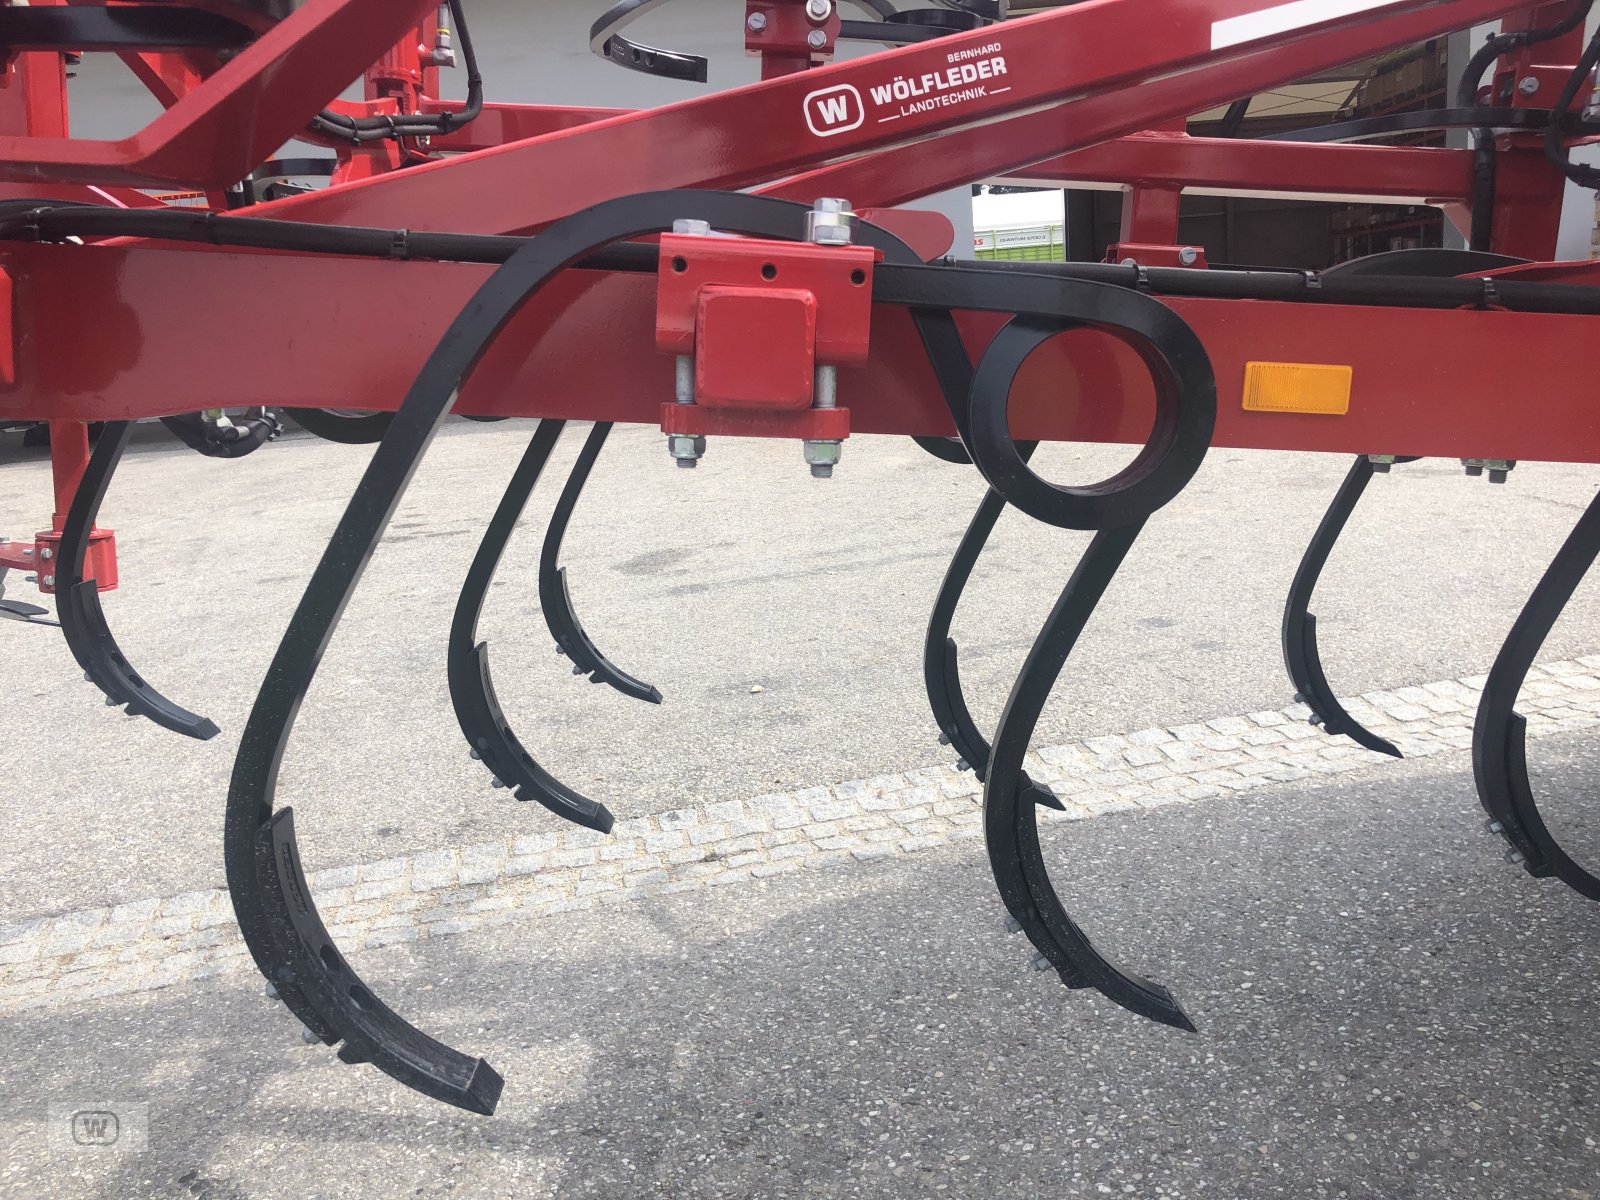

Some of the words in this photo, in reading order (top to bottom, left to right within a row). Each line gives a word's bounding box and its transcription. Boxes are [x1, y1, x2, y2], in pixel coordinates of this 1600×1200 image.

[947, 42, 1001, 63] BERNHARD
[870, 56, 1007, 106] WÖLFLEDER
[816, 95, 847, 125] W
[901, 86, 987, 117] LANDTECHNIK
